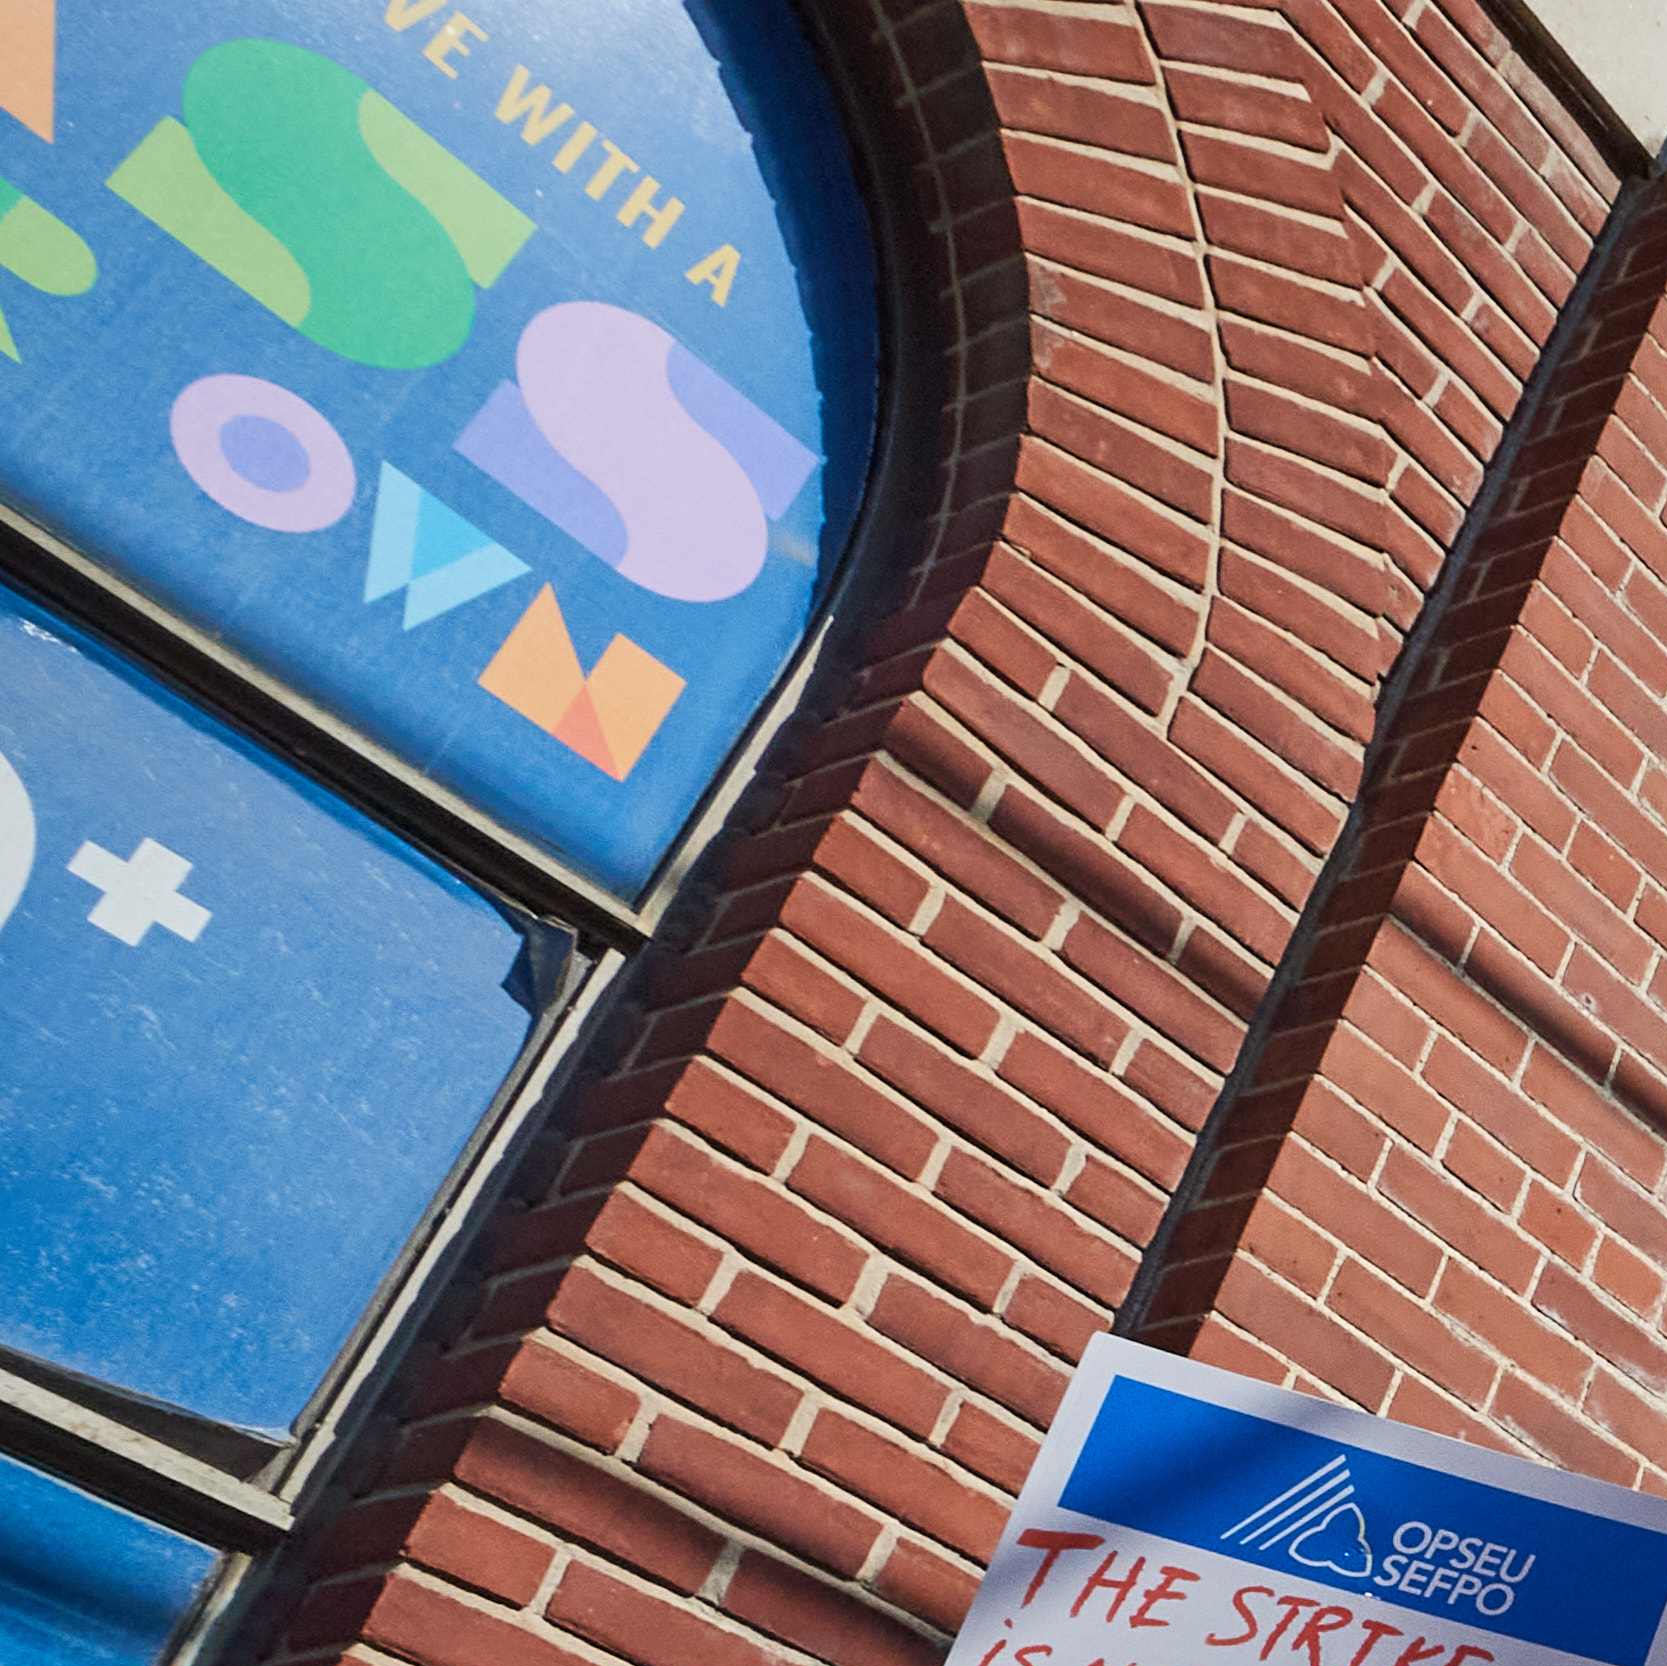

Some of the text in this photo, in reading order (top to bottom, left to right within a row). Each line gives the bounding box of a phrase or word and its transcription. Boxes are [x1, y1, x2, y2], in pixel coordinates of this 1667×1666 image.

[493, 64, 687, 250] WITH
[683, 243, 742, 308] A
[1016, 1528, 1201, 1628] THE
[1373, 1554, 1515, 1616] SEFPO
[1392, 1521, 1536, 1583] OPSEU
